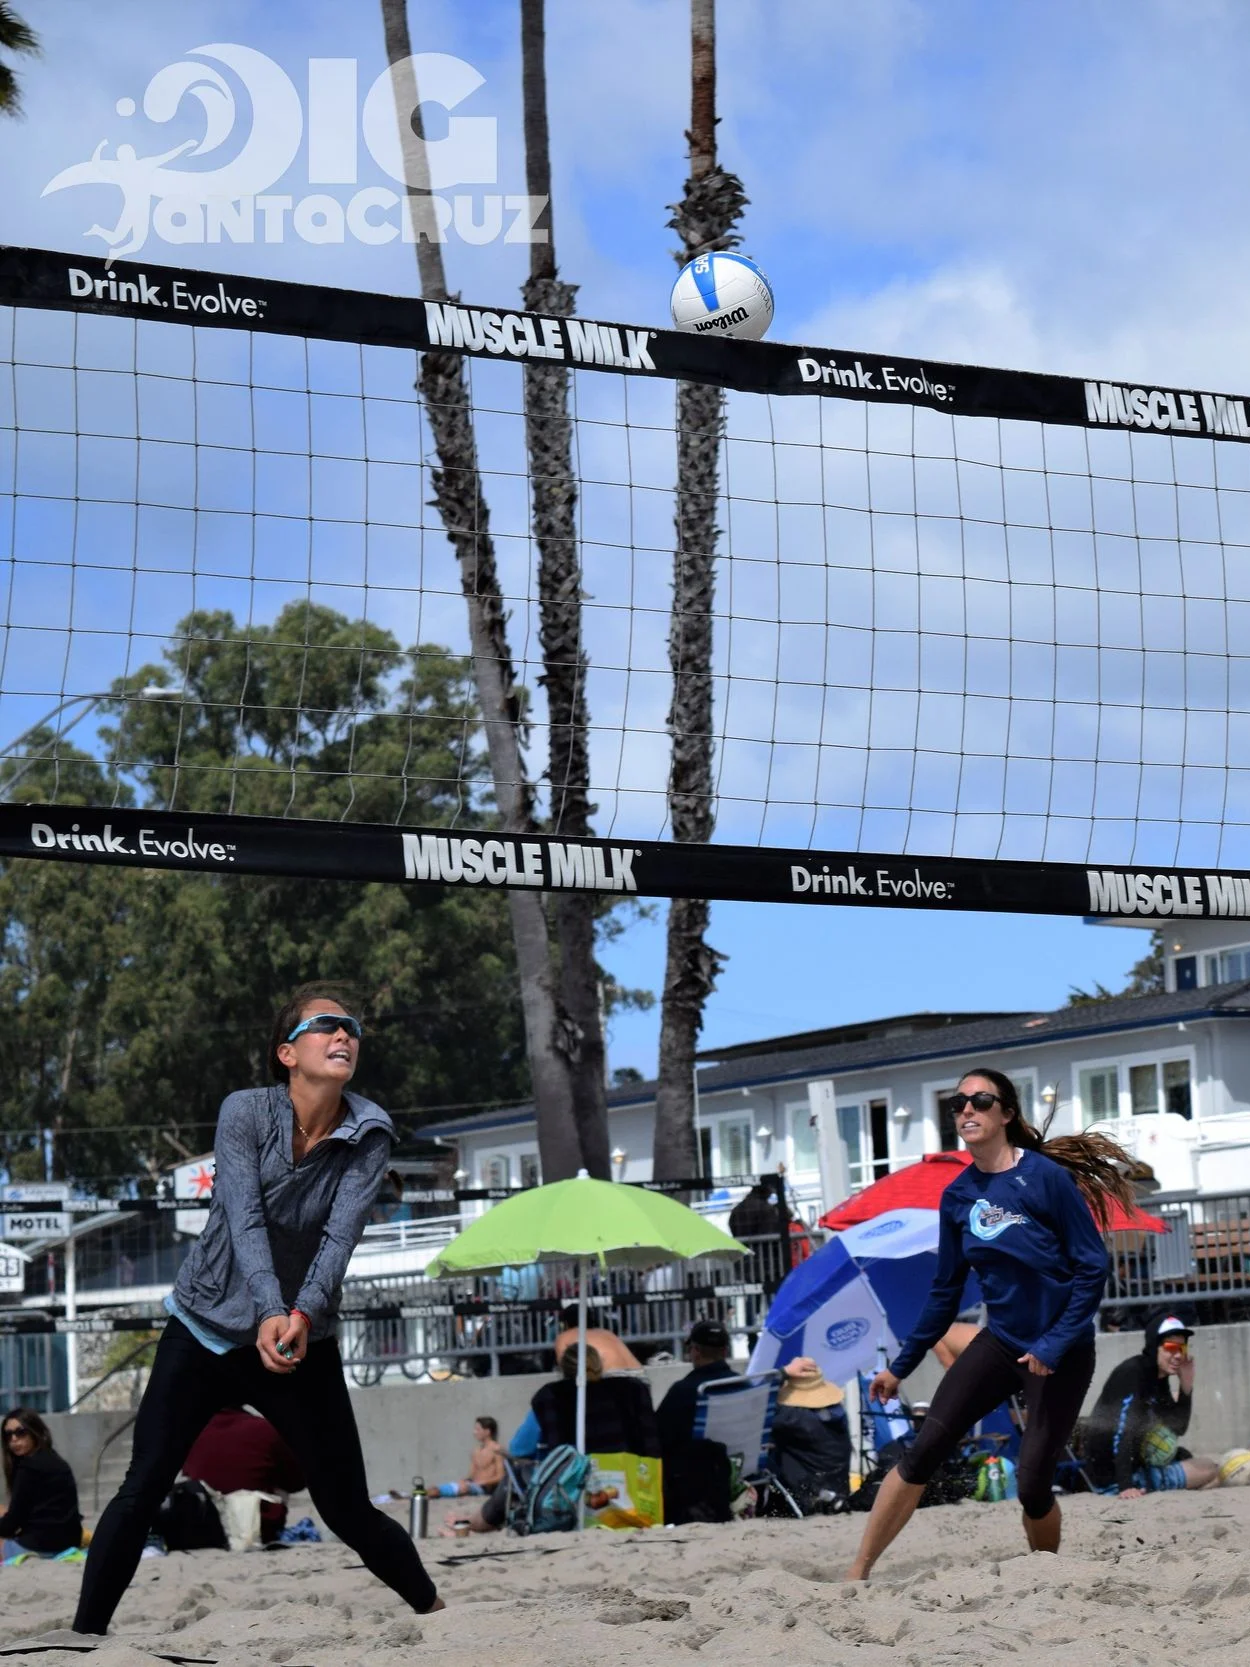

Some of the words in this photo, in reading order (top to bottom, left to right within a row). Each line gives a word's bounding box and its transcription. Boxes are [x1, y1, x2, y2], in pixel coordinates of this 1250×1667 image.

[424, 301, 564, 359] MUSCLE
[693, 306, 750, 332] Wilson
[1084, 381, 1200, 432] MUSCLE
[401, 833, 544, 887] MUSCLE
[1086, 870, 1203, 916] MUSCLE
[10, 1218, 62, 1230] MOTEL
